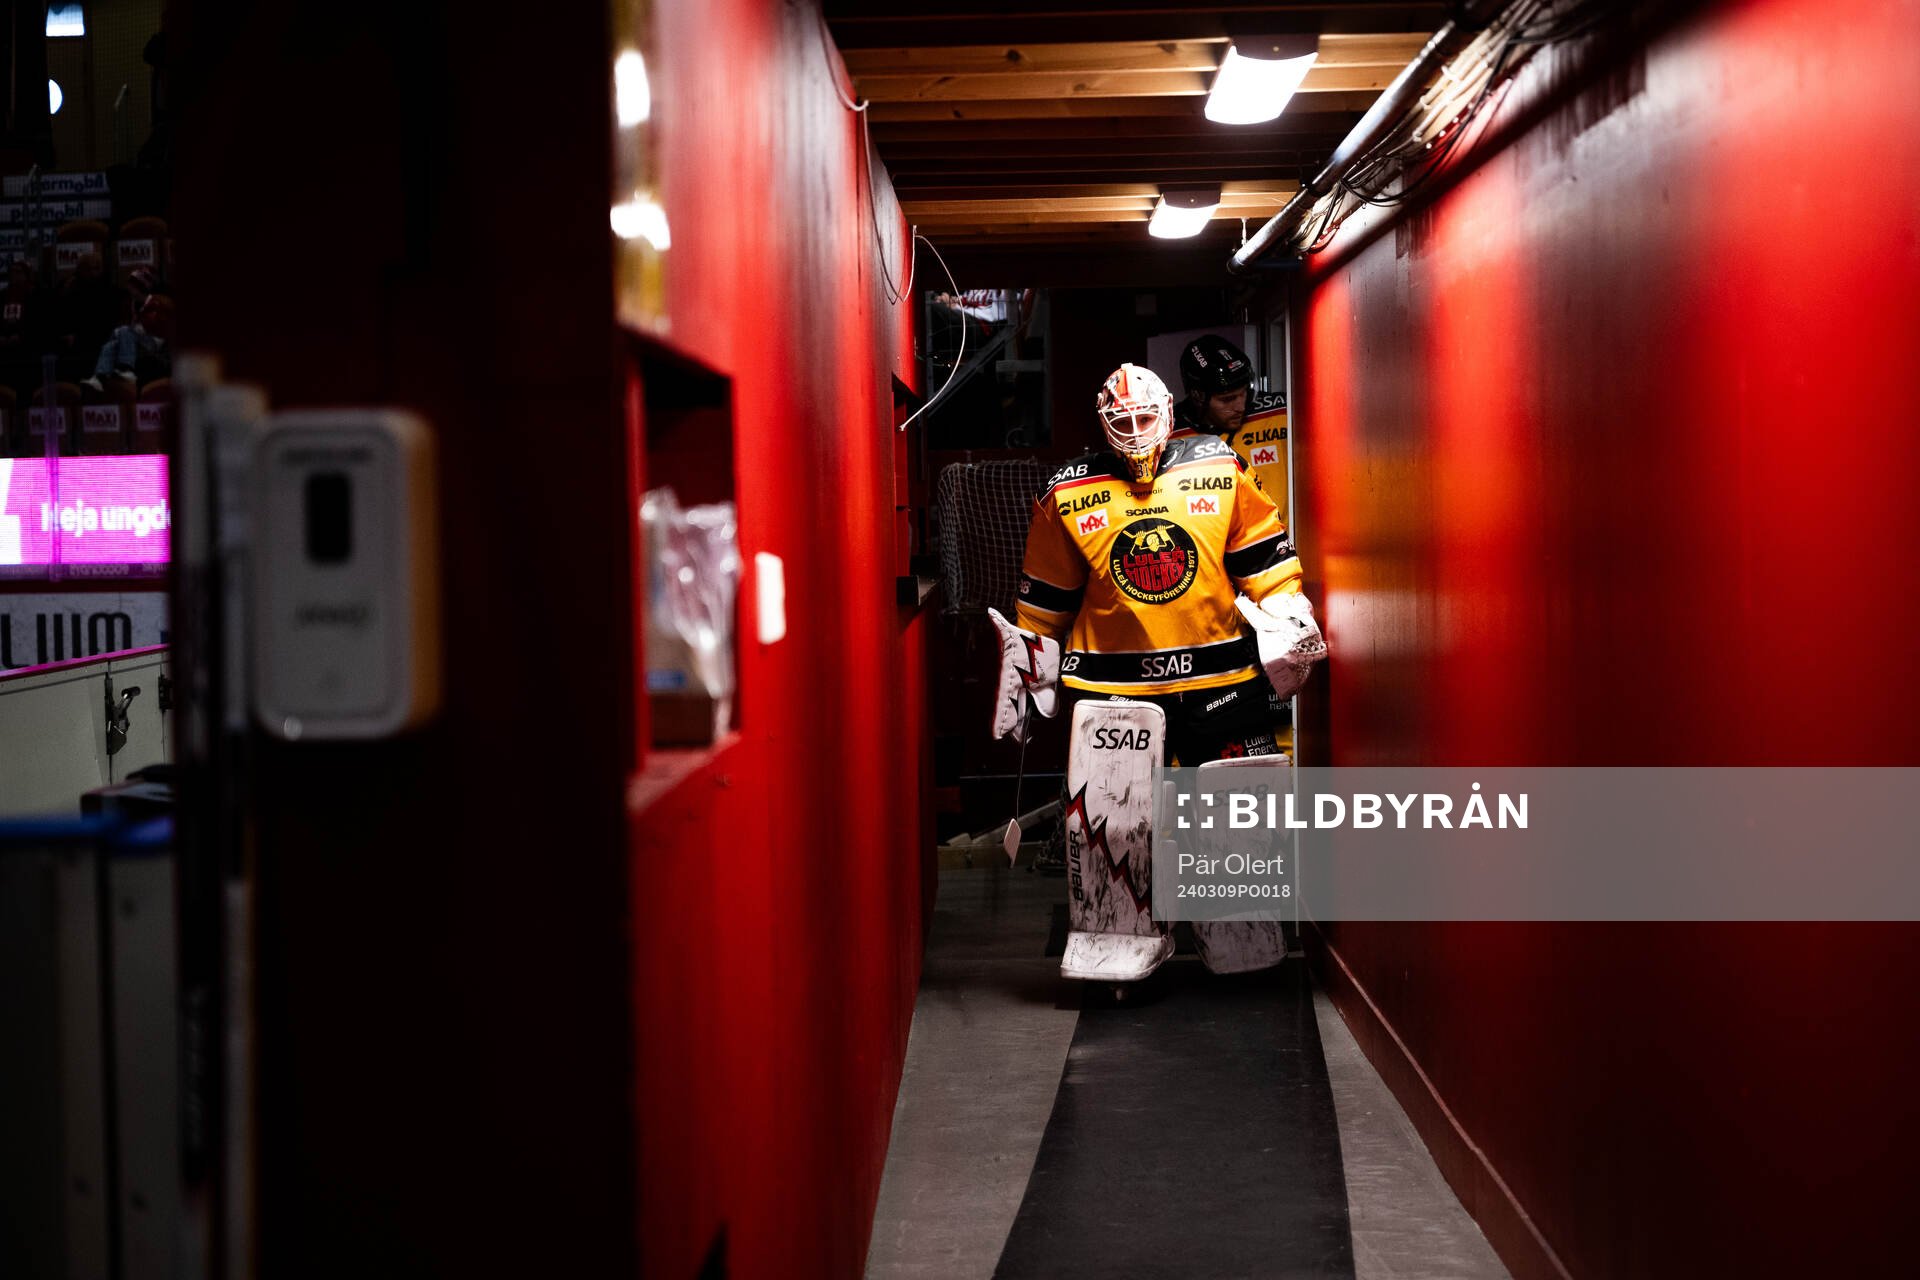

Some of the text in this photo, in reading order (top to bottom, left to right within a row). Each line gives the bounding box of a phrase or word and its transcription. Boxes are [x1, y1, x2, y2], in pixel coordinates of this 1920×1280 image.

[1252, 394, 1286, 410] SSA
[1255, 427, 1287, 444] LKAB
[1253, 448, 1275, 465] MAX
[1193, 476, 1233, 491] LKAB
[1072, 489, 1112, 513] LKAB
[1189, 496, 1216, 514] MAX
[1125, 505, 1169, 517] SCANIA
[1080, 514, 1106, 533] MAX
[1122, 545, 1186, 569] LULEÅ
[1140, 652, 1193, 678] SSAB
[1092, 727, 1152, 751] SSAB
